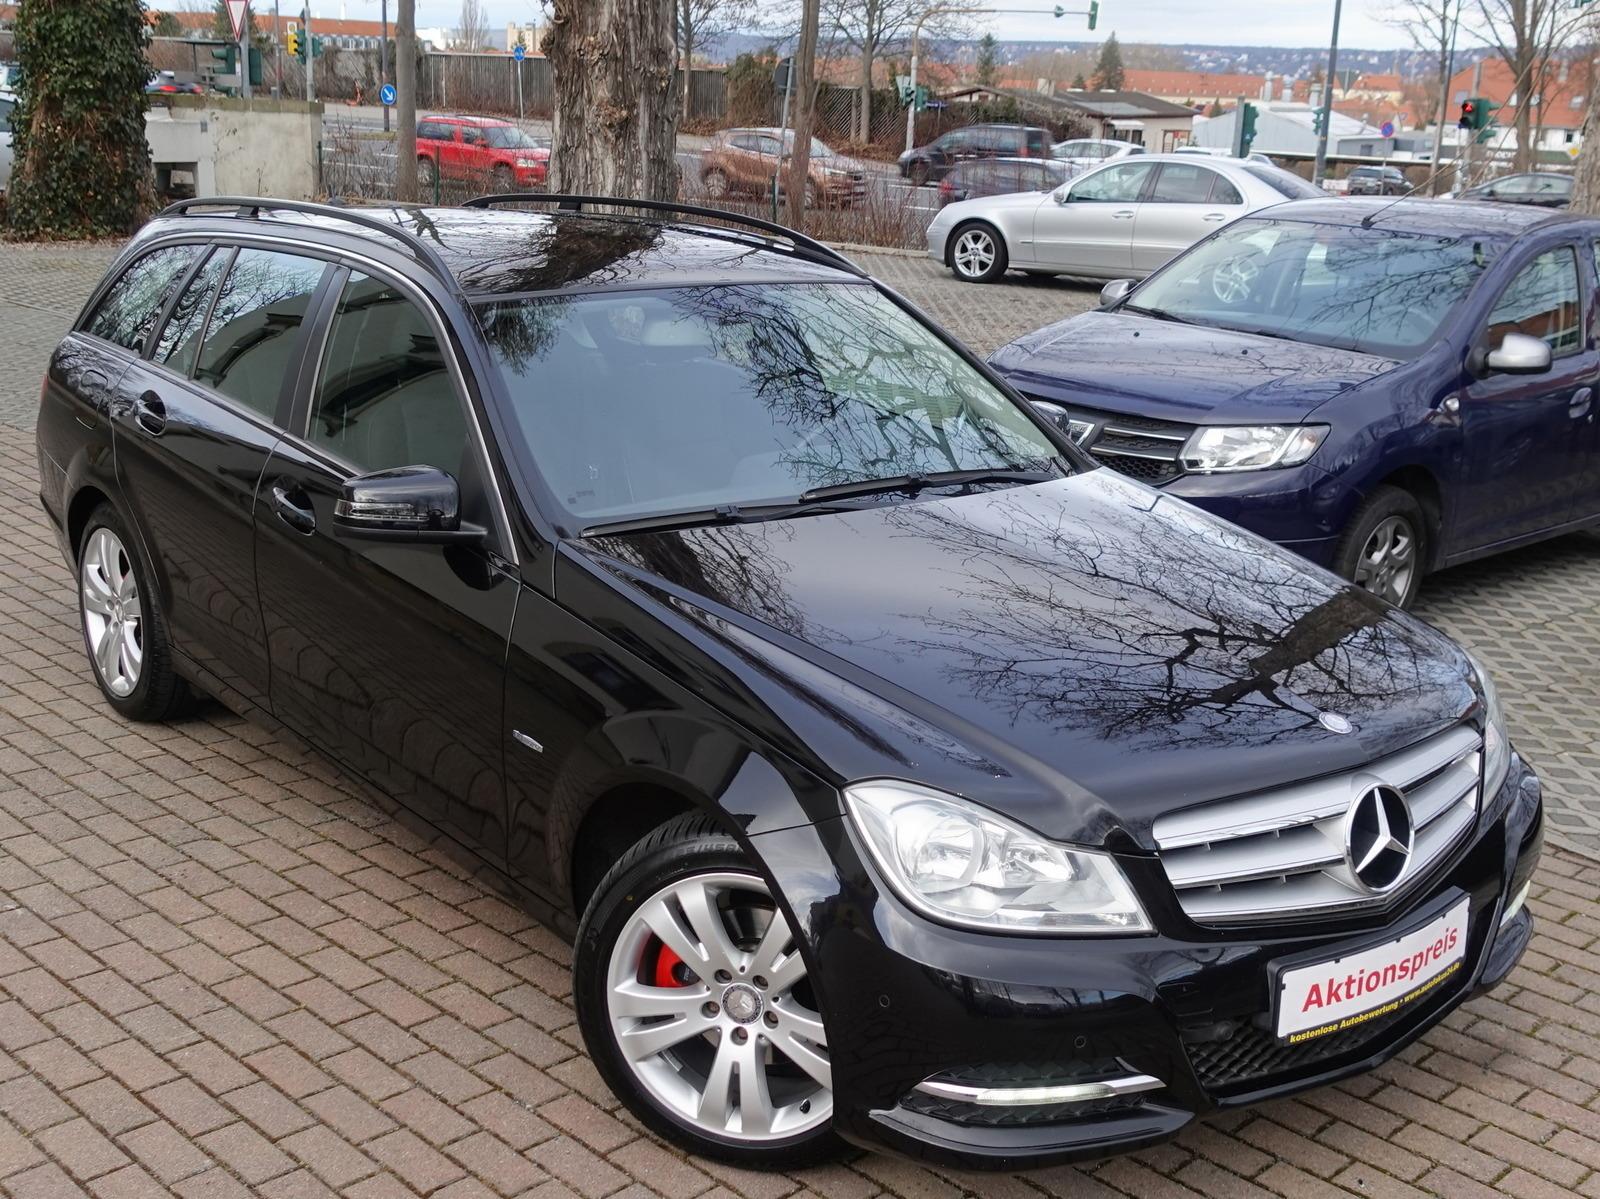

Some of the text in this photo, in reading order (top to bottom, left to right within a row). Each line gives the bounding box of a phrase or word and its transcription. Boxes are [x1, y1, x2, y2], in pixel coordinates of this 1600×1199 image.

[1302, 926, 1458, 1013] Aktionspreis
[1290, 1023, 1338, 1043] kostenlose
[1340, 1001, 1399, 1028] Autobewertung
